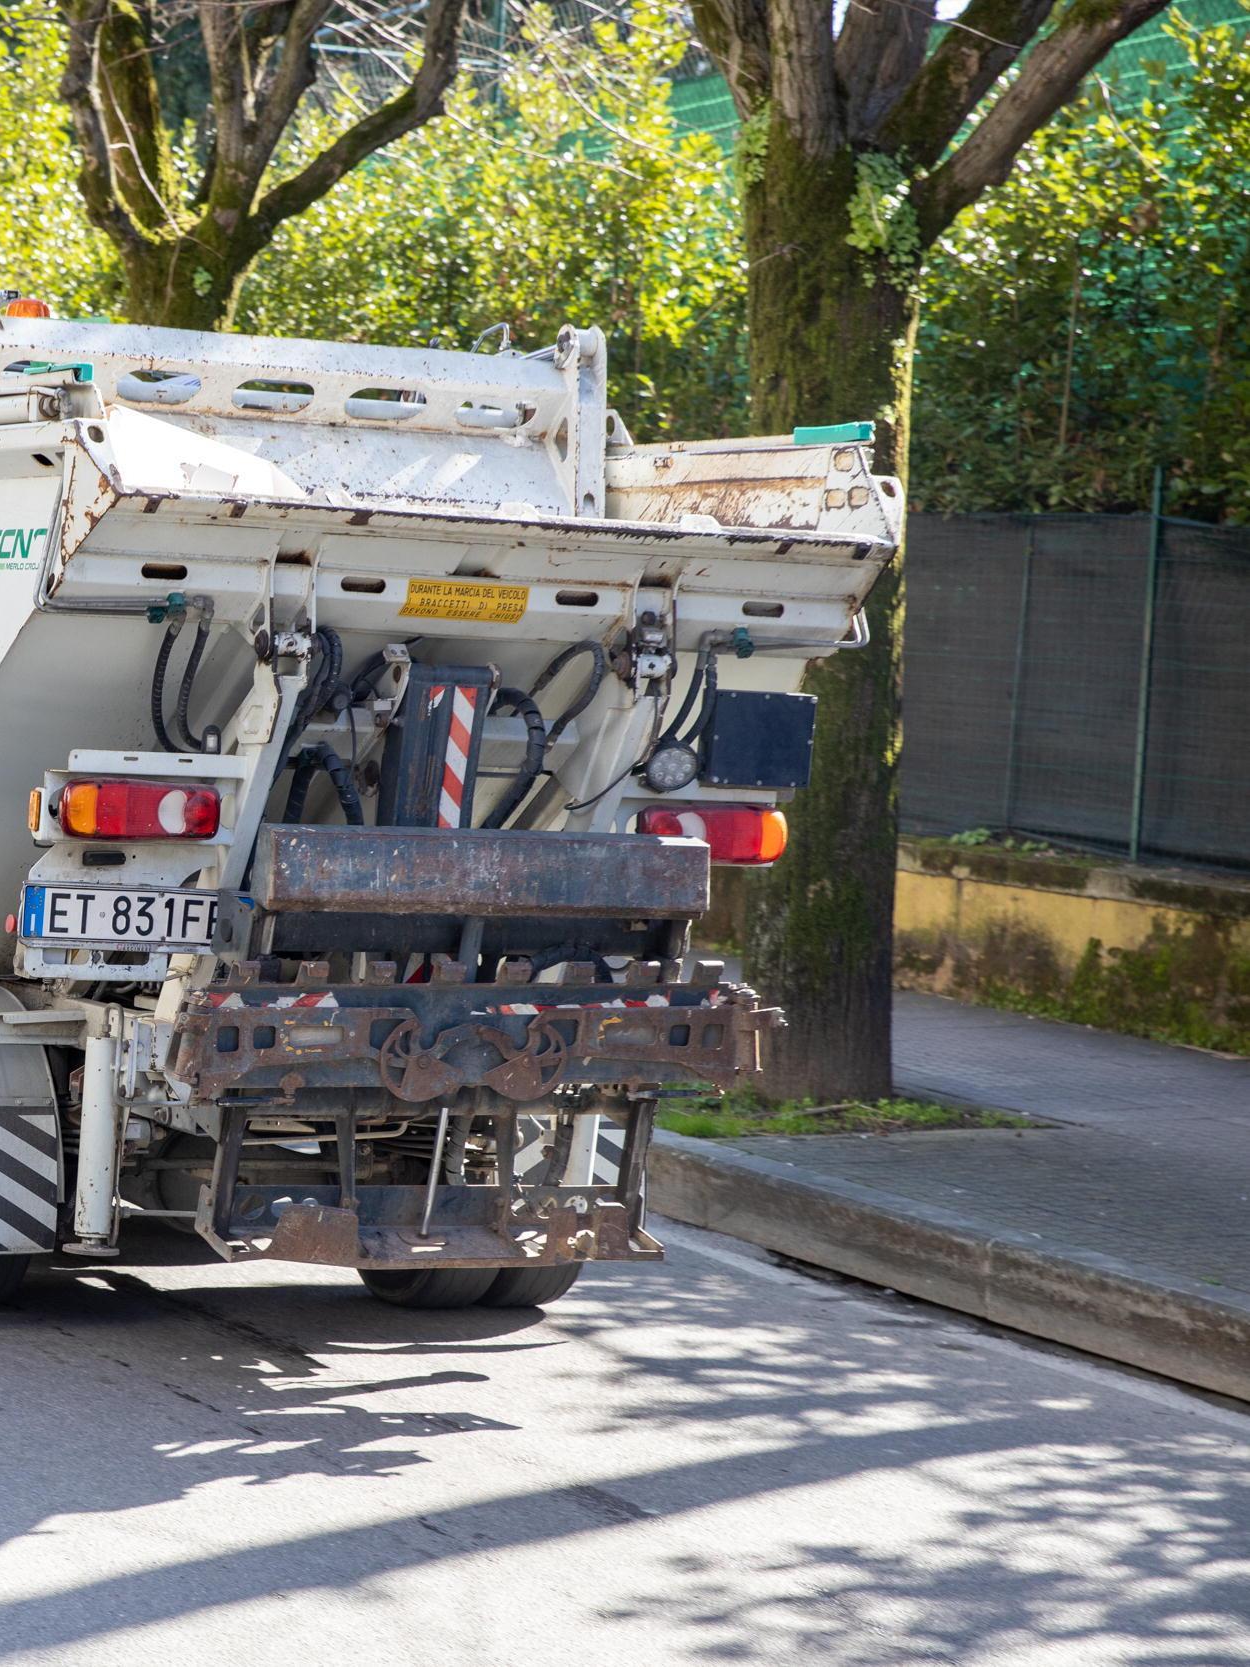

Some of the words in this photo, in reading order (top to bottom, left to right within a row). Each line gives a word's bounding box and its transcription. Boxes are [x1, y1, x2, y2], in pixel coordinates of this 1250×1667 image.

[410, 584, 441, 596] DURANTE
[443, 587, 452, 596] LA
[454, 587, 480, 597] MARCIA
[482, 588, 495, 599] DEL
[498, 589, 526, 600] VEICOLO
[419, 597, 471, 609] BRACCETTI
[479, 601, 488, 610] DI
[496, 603, 525, 612] PRESA
[403, 607, 439, 615] DEVONO
[446, 610, 482, 618] ESSERE
[49, 892, 95, 934] ET
